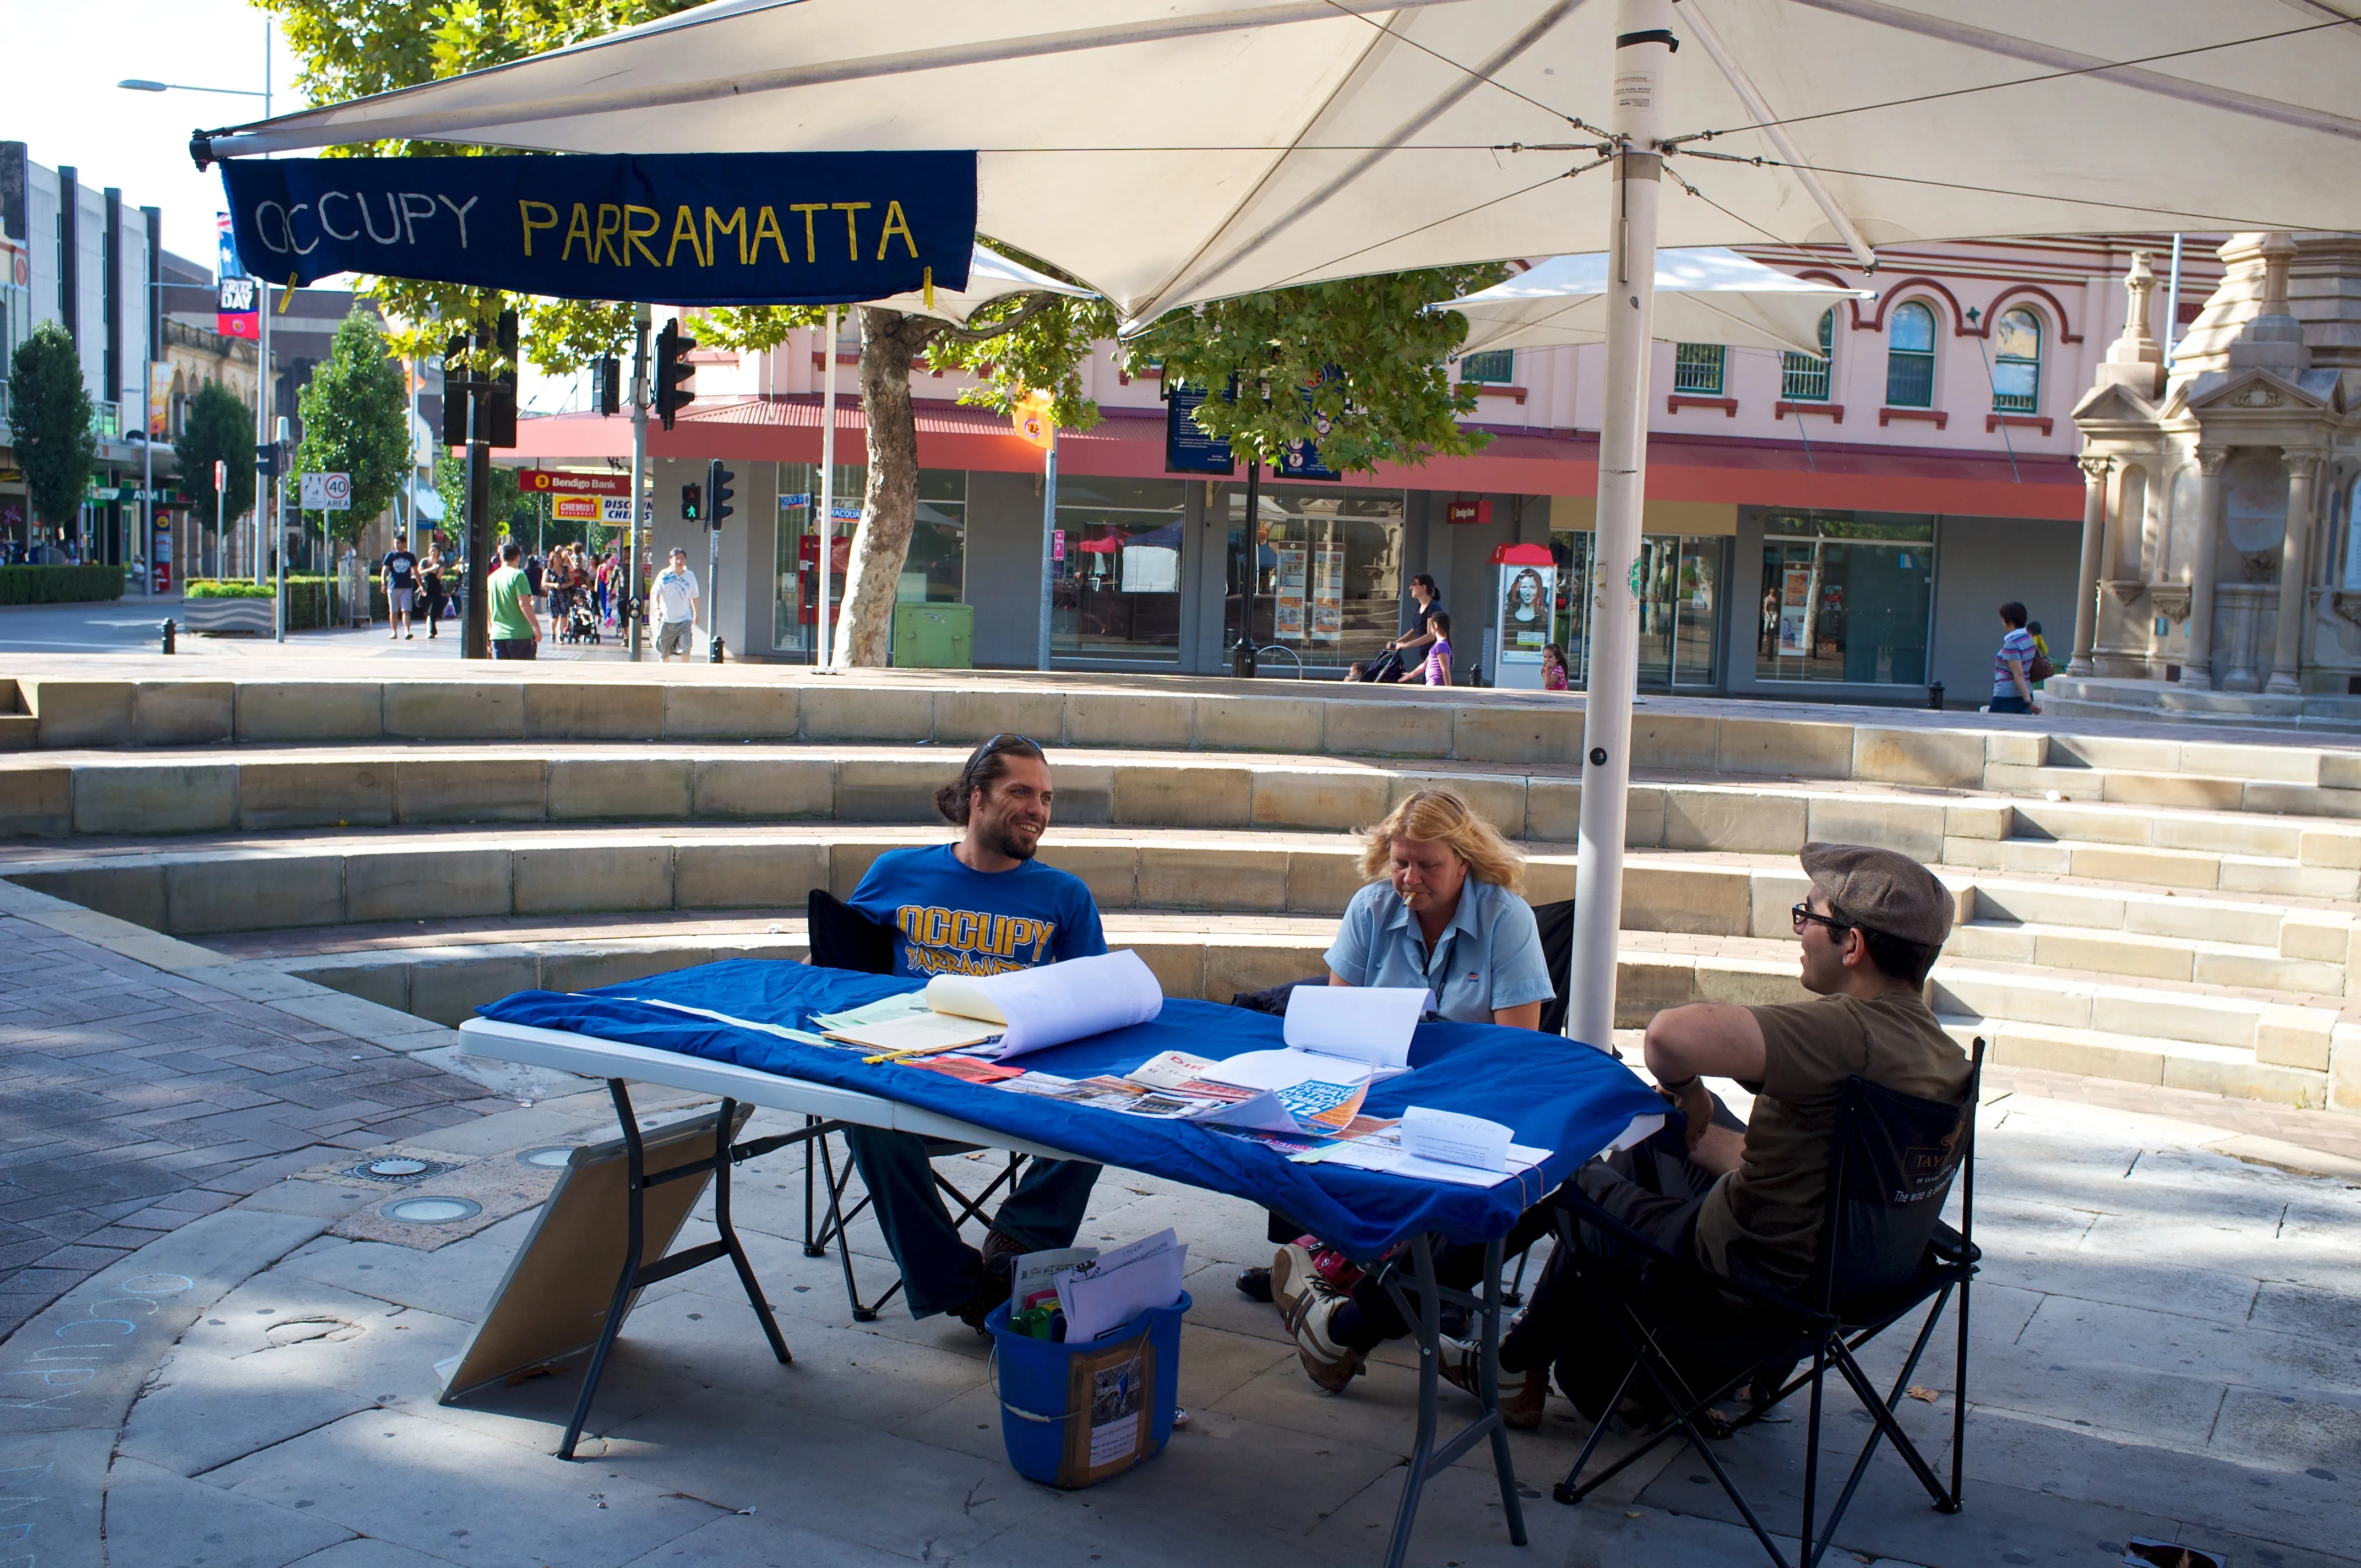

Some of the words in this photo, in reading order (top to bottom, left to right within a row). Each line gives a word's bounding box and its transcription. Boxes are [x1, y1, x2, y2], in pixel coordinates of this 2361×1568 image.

[255, 190, 478, 255] OCCUPY
[519, 199, 919, 268] PARRAMATTA
[221, 292, 253, 310] DAY
[329, 481, 346, 493] 40
[552, 478, 590, 489] Bendigo
[591, 480, 616, 489] Bank
[560, 502, 595, 512] CHEMIST
[781, 496, 797, 504] CHURCH
[831, 509, 861, 519] MACQUA
[896, 905, 1058, 962] OCCUPY
[1282, 1088, 1348, 1106] ACTION
[1296, 1084, 1356, 1099] CLIMATE
[1277, 1091, 1336, 1110] SUMMIT
[1280, 1098, 1321, 1117] 012
[1895, 1190, 1908, 1202] The
[1910, 1190, 1925, 1202] wine
[0, 1273, 194, 1411] OCCUPY
